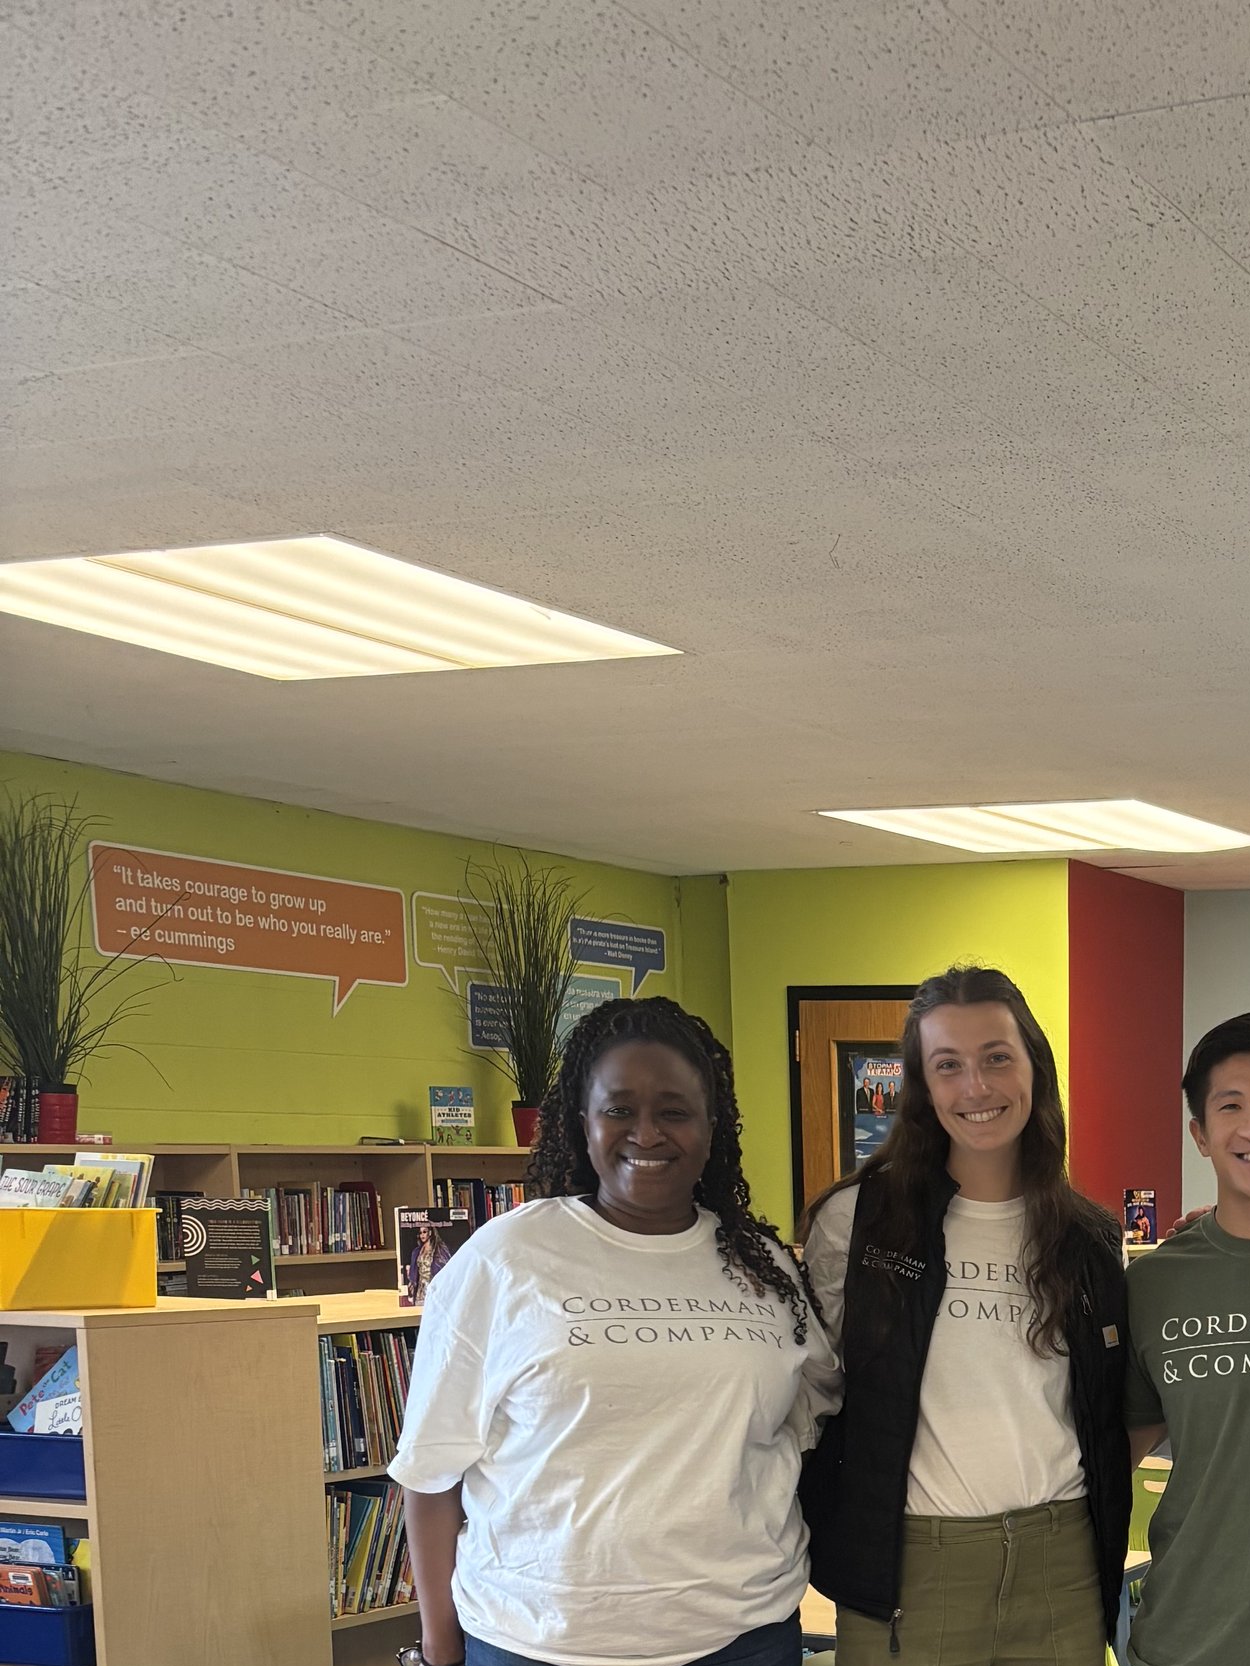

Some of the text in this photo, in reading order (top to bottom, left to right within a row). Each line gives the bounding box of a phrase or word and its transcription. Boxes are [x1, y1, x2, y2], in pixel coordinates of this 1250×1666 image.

[137, 869, 181, 892] takes
[185, 880, 248, 904] courage
[251, 886, 266, 904] to
[270, 892, 305, 910] grow
[309, 898, 326, 916] up
[115, 897, 391, 945] and turn out to be who you really are.”
[130, 926, 151, 941] ee
[154, 929, 236, 954] cummings
[14, 1177, 38, 1195] SOUR
[36, 1180, 66, 1198] GRAPE
[400, 1209, 428, 1222] BEYONCÉ
[865, 1244, 927, 1270] CODEMAN
[562, 1296, 776, 1318] CORDERMAN
[568, 1324, 784, 1349] & COMPANY
[1163, 1360, 1183, 1384] &
[18, 1390, 45, 1416] Pete
[50, 1360, 72, 1383] Cat
